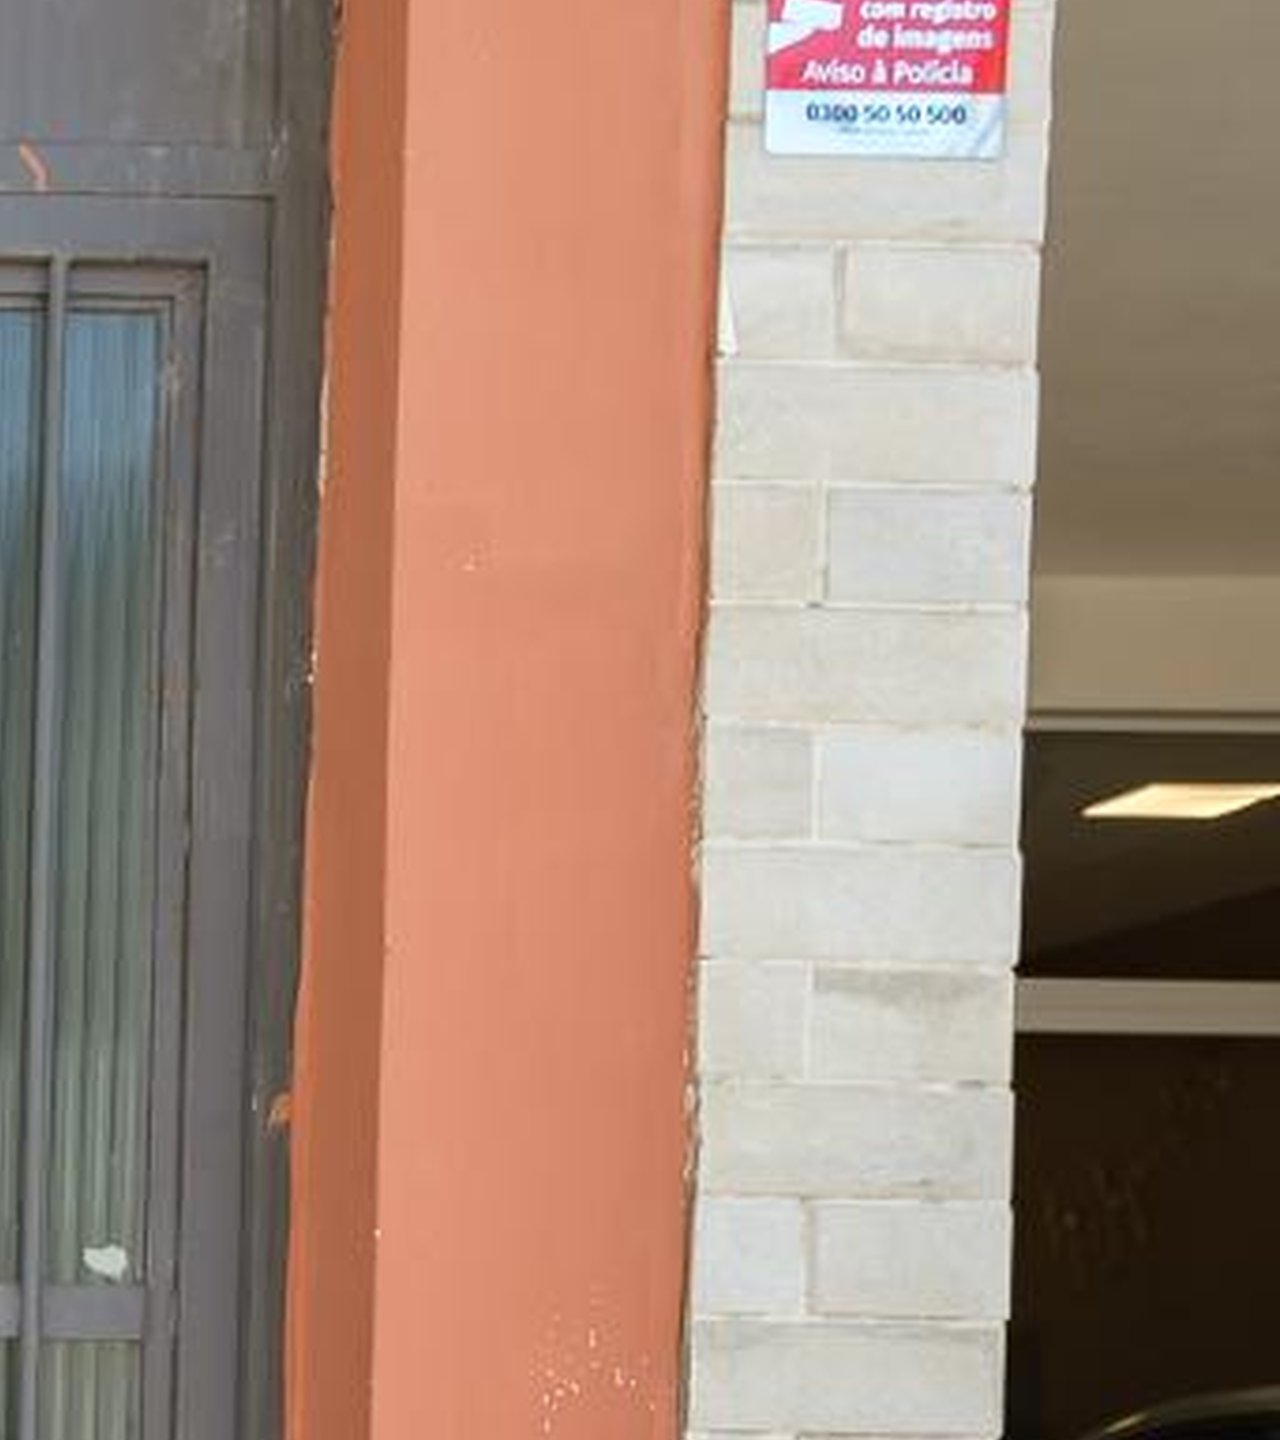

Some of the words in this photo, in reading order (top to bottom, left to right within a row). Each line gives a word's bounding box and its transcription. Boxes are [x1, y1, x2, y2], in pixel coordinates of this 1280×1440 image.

[859, 1, 906, 20] com
[856, 25, 890, 49] de
[801, 59, 866, 85] Aviso
